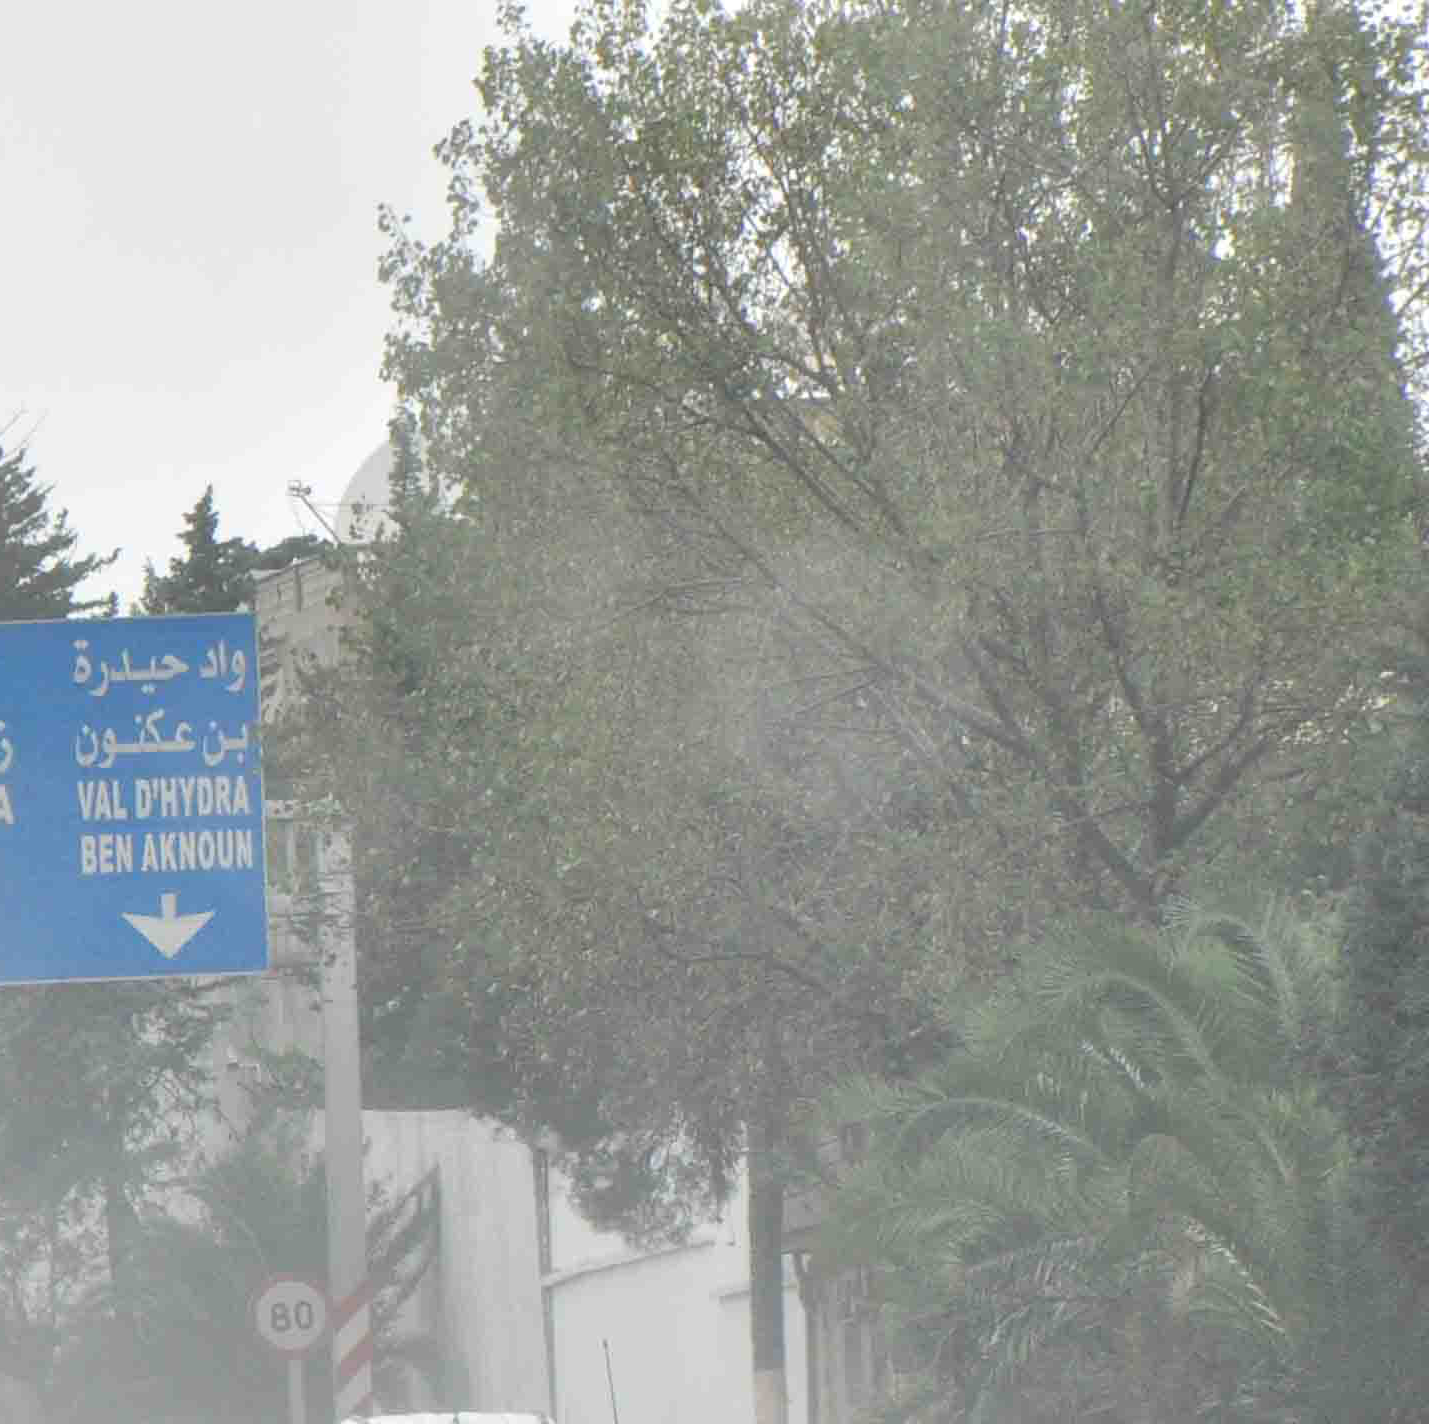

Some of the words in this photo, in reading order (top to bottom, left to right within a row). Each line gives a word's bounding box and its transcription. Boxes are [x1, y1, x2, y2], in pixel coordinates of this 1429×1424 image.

[72, 638, 190, 697] حيدرة
[197, 638, 247, 692] واد
[74, 707, 197, 769] عكنون
[202, 720, 249, 768] بن
[76, 778, 129, 822] VAL
[133, 775, 252, 820] D'HYDRA
[79, 833, 134, 875] BEN
[140, 828, 254, 872] AKNOUN
[271, 1301, 314, 1332] 80
